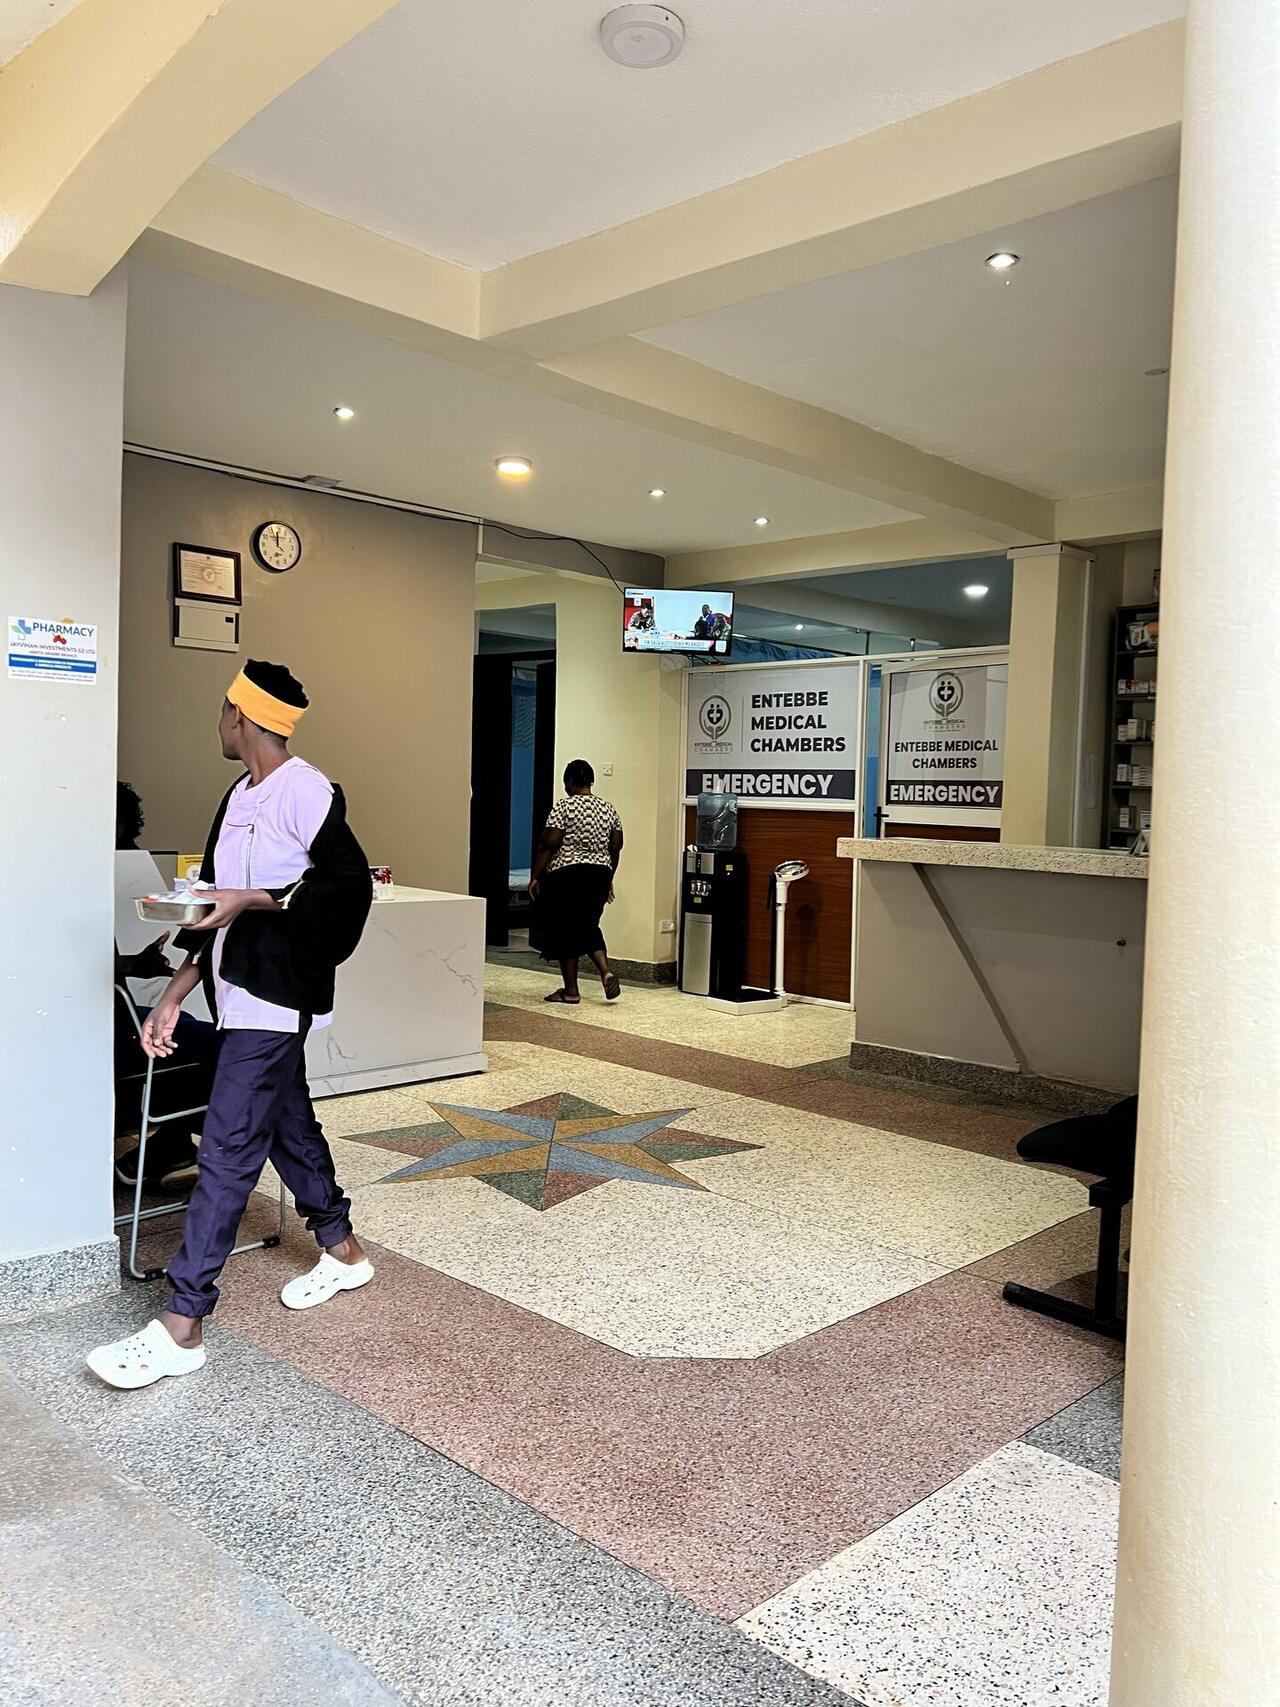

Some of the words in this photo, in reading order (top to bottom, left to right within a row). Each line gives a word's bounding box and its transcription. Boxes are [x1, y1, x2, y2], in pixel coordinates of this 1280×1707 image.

[33, 622, 94, 636] PHARMACY
[39, 643, 77, 653] INVESTMENTS
[751, 691, 829, 709] ENTEBBE
[751, 714, 827, 731] MEDICAL
[750, 737, 846, 753] CHAMBERS
[895, 741, 942, 753] ENTEBBE
[944, 739, 998, 752] MEDICAL
[912, 757, 978, 769] CHAMBERS
[702, 773, 834, 796] EMERGENCY
[890, 784, 1000, 804] EMERGENCY
